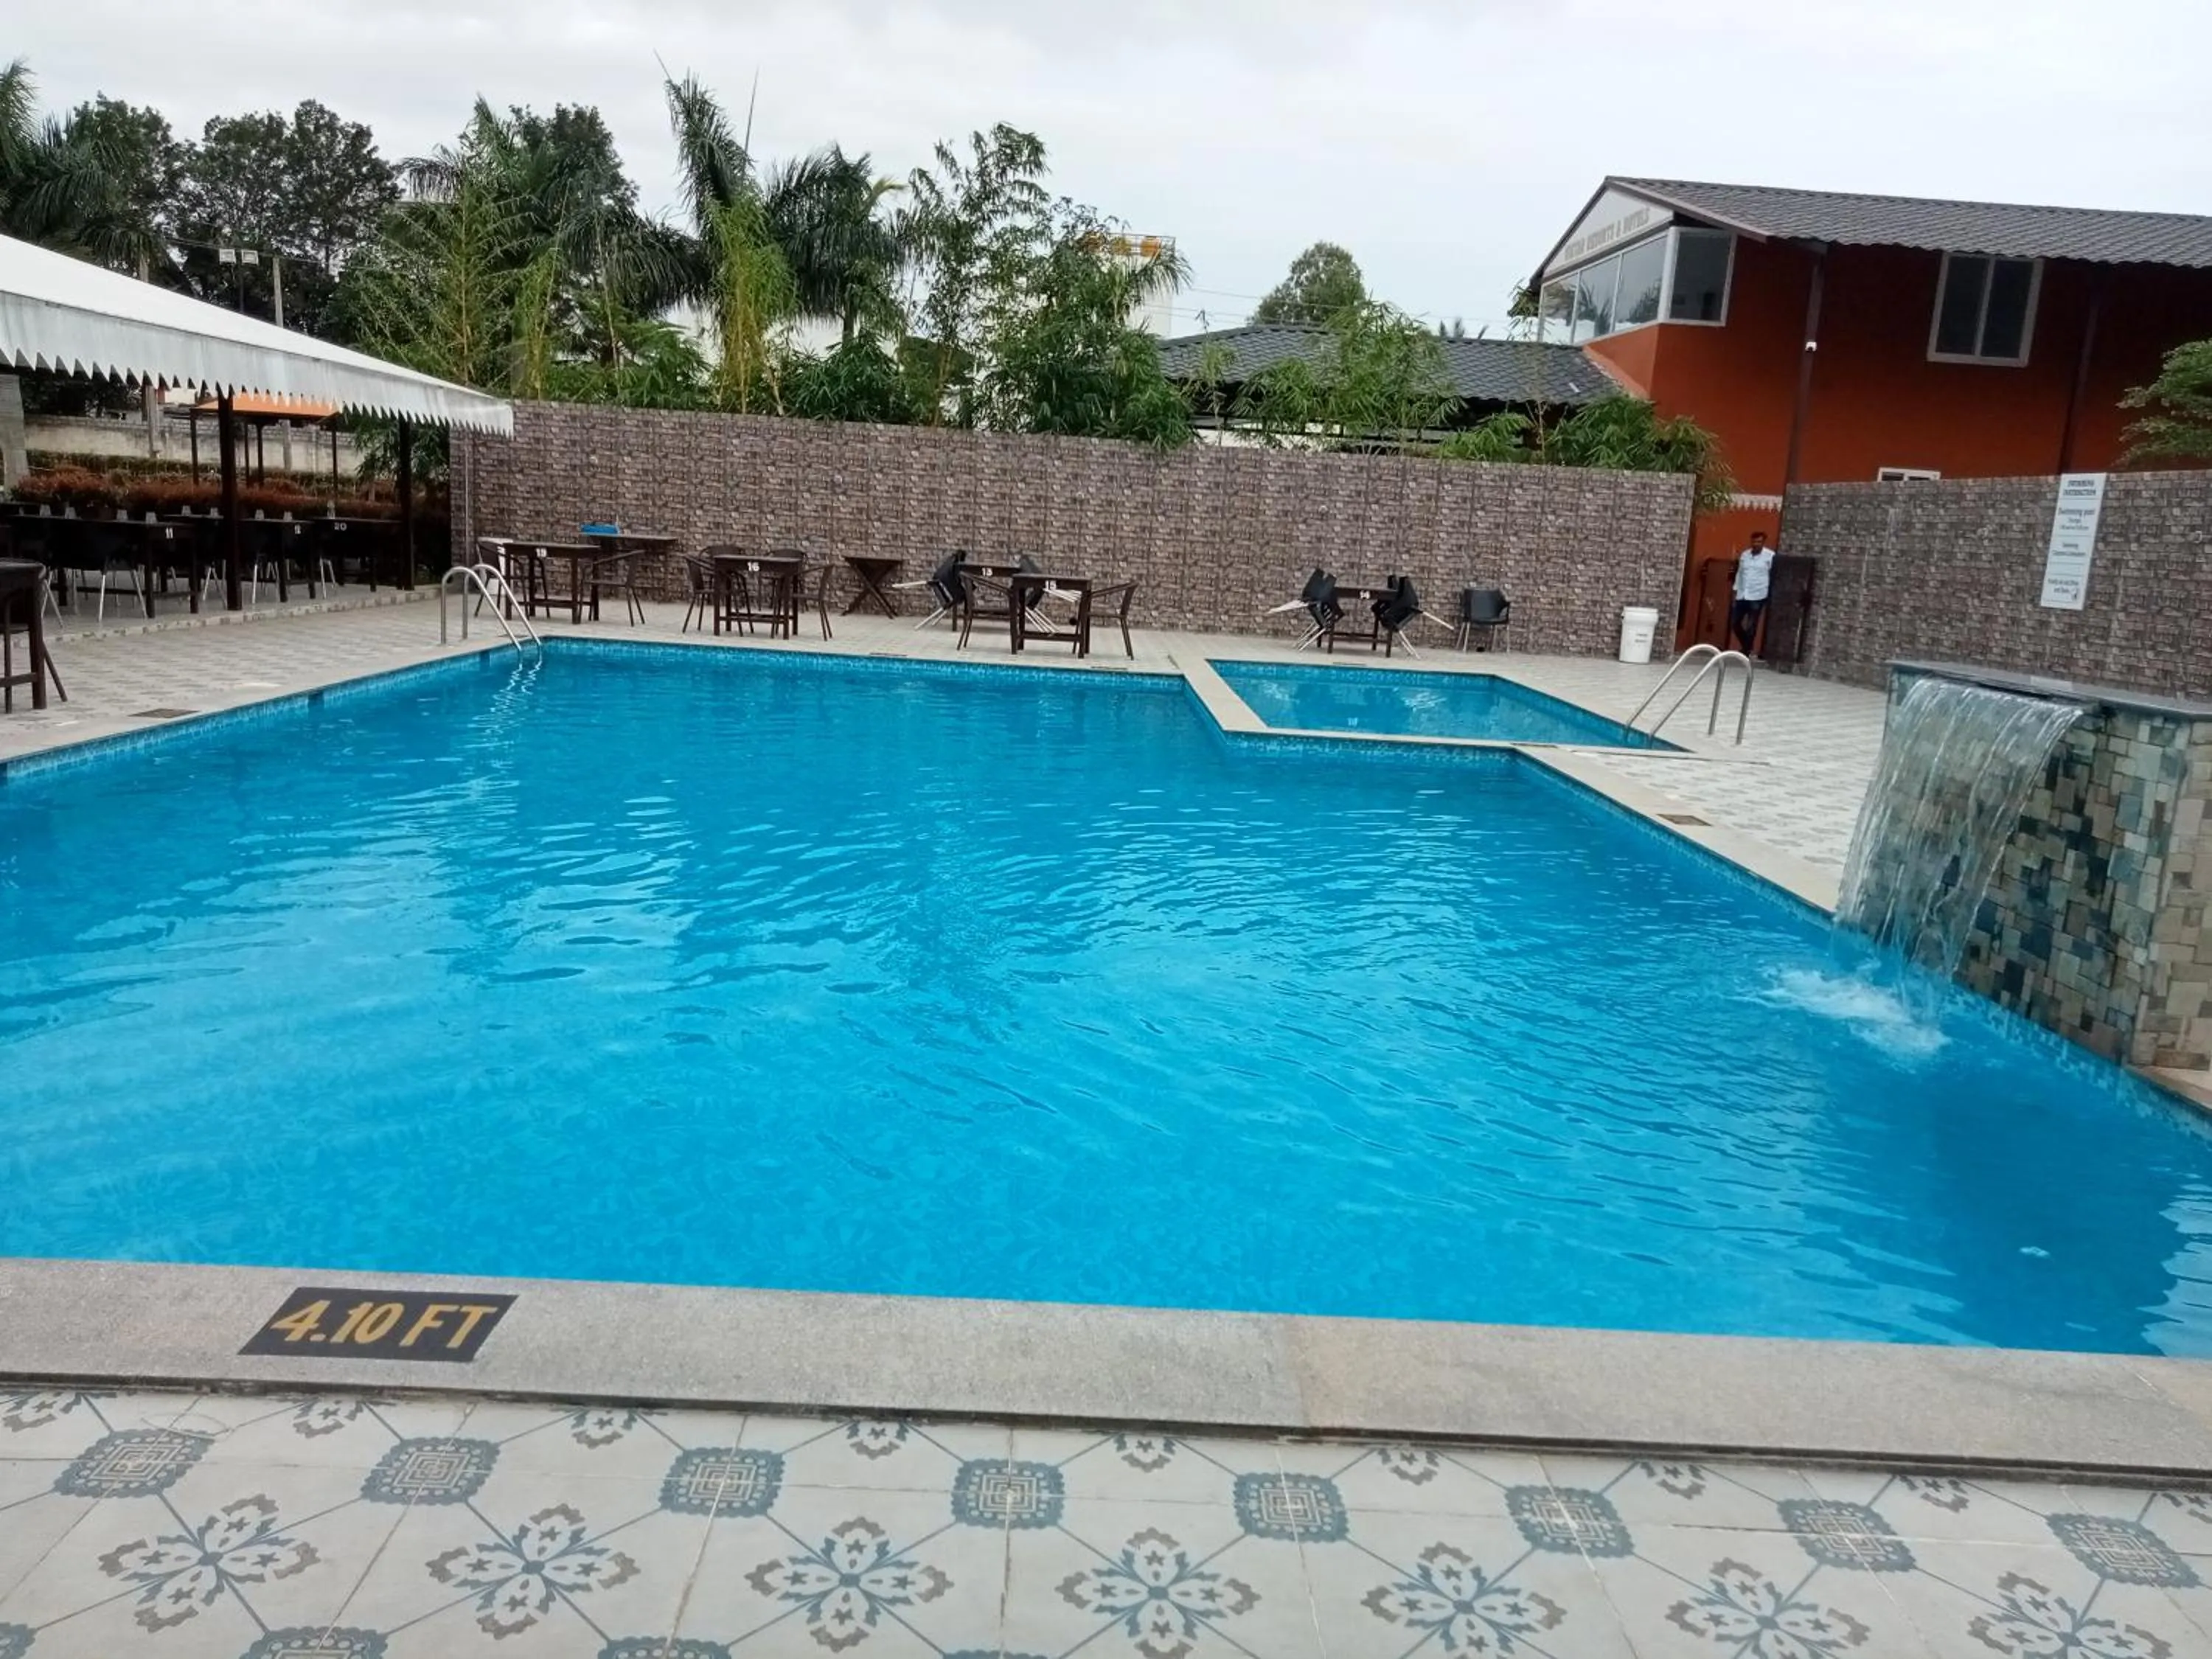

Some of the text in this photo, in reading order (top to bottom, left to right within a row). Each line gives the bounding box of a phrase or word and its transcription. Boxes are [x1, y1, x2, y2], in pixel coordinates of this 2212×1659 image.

[747, 561, 759, 571] 16
[270, 1299, 498, 1349] 4.10 FT
